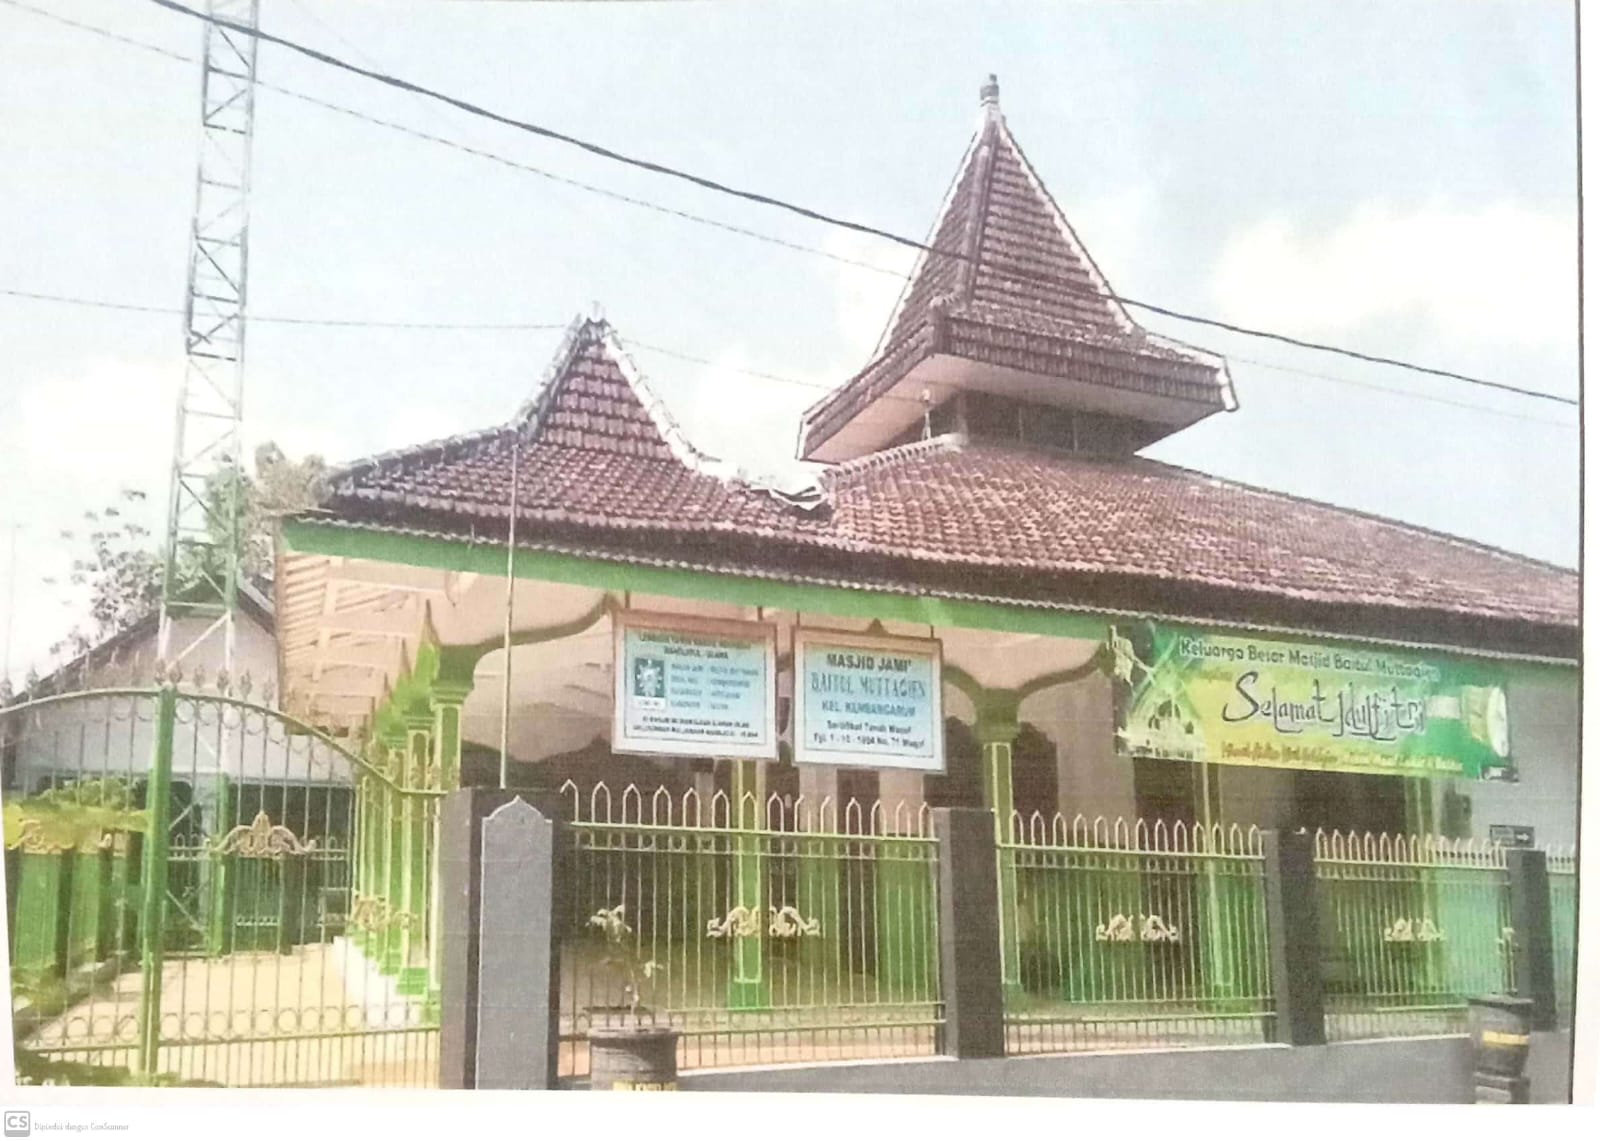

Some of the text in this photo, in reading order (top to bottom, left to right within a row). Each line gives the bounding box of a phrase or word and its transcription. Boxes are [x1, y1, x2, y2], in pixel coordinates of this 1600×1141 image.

[826, 653, 874, 671] MASJID
[1179, 636, 1244, 661] Keluarga
[1248, 645, 1285, 664] Besar
[1289, 650, 1330, 669] Masjid
[1221, 671, 1335, 733] Selamat
